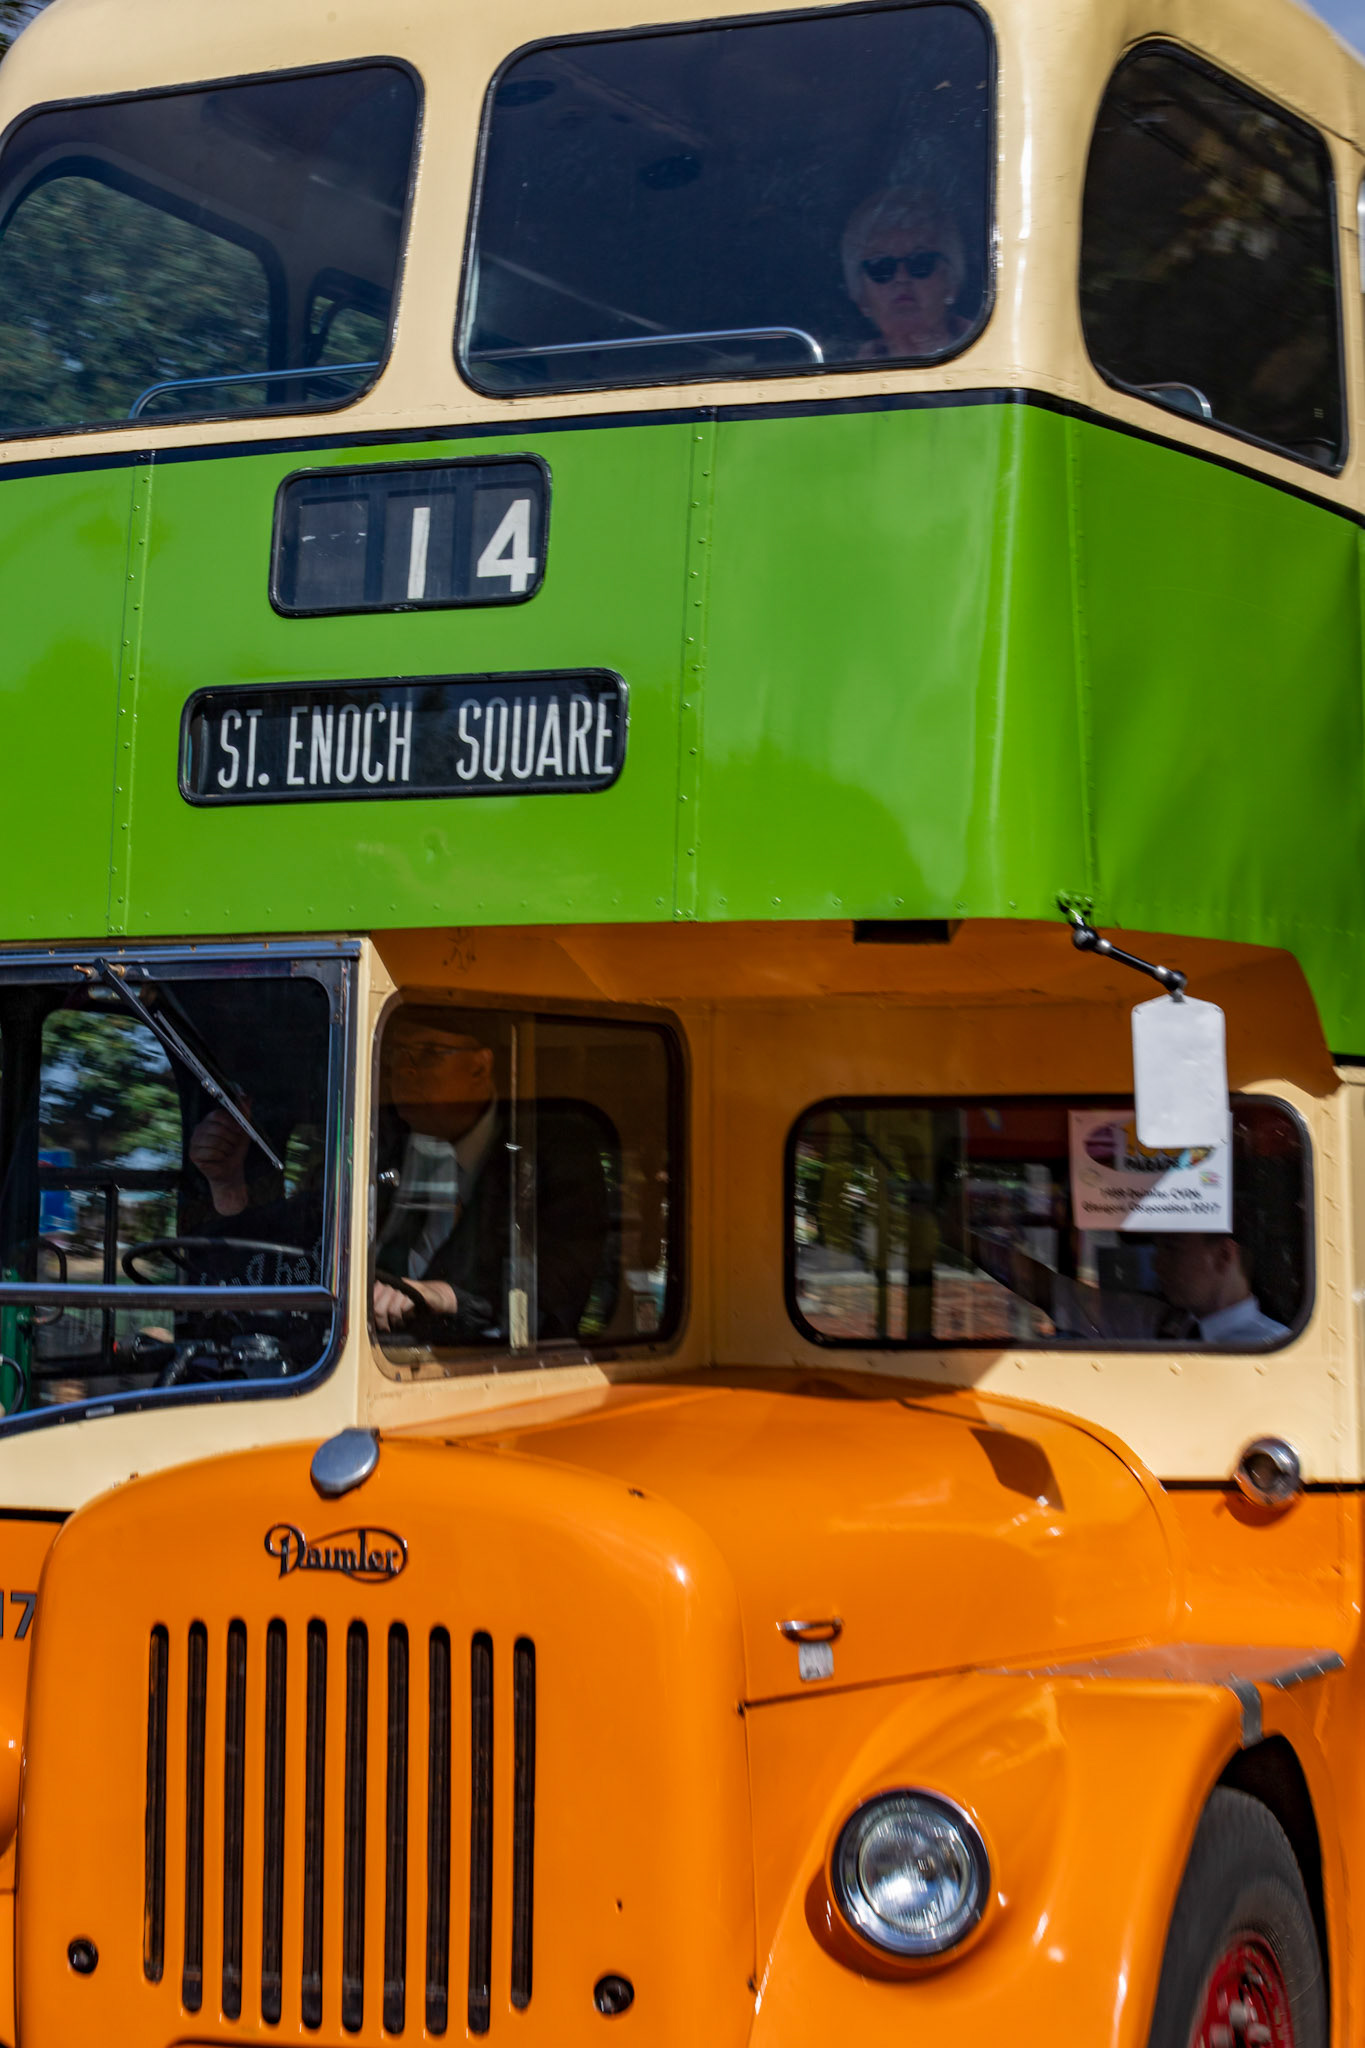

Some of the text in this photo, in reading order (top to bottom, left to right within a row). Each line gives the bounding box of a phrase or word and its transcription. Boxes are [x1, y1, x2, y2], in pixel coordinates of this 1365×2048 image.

[217, 693, 618, 789] ST. ENOCH SQUARE
[264, 1522, 408, 1587] Daimler
